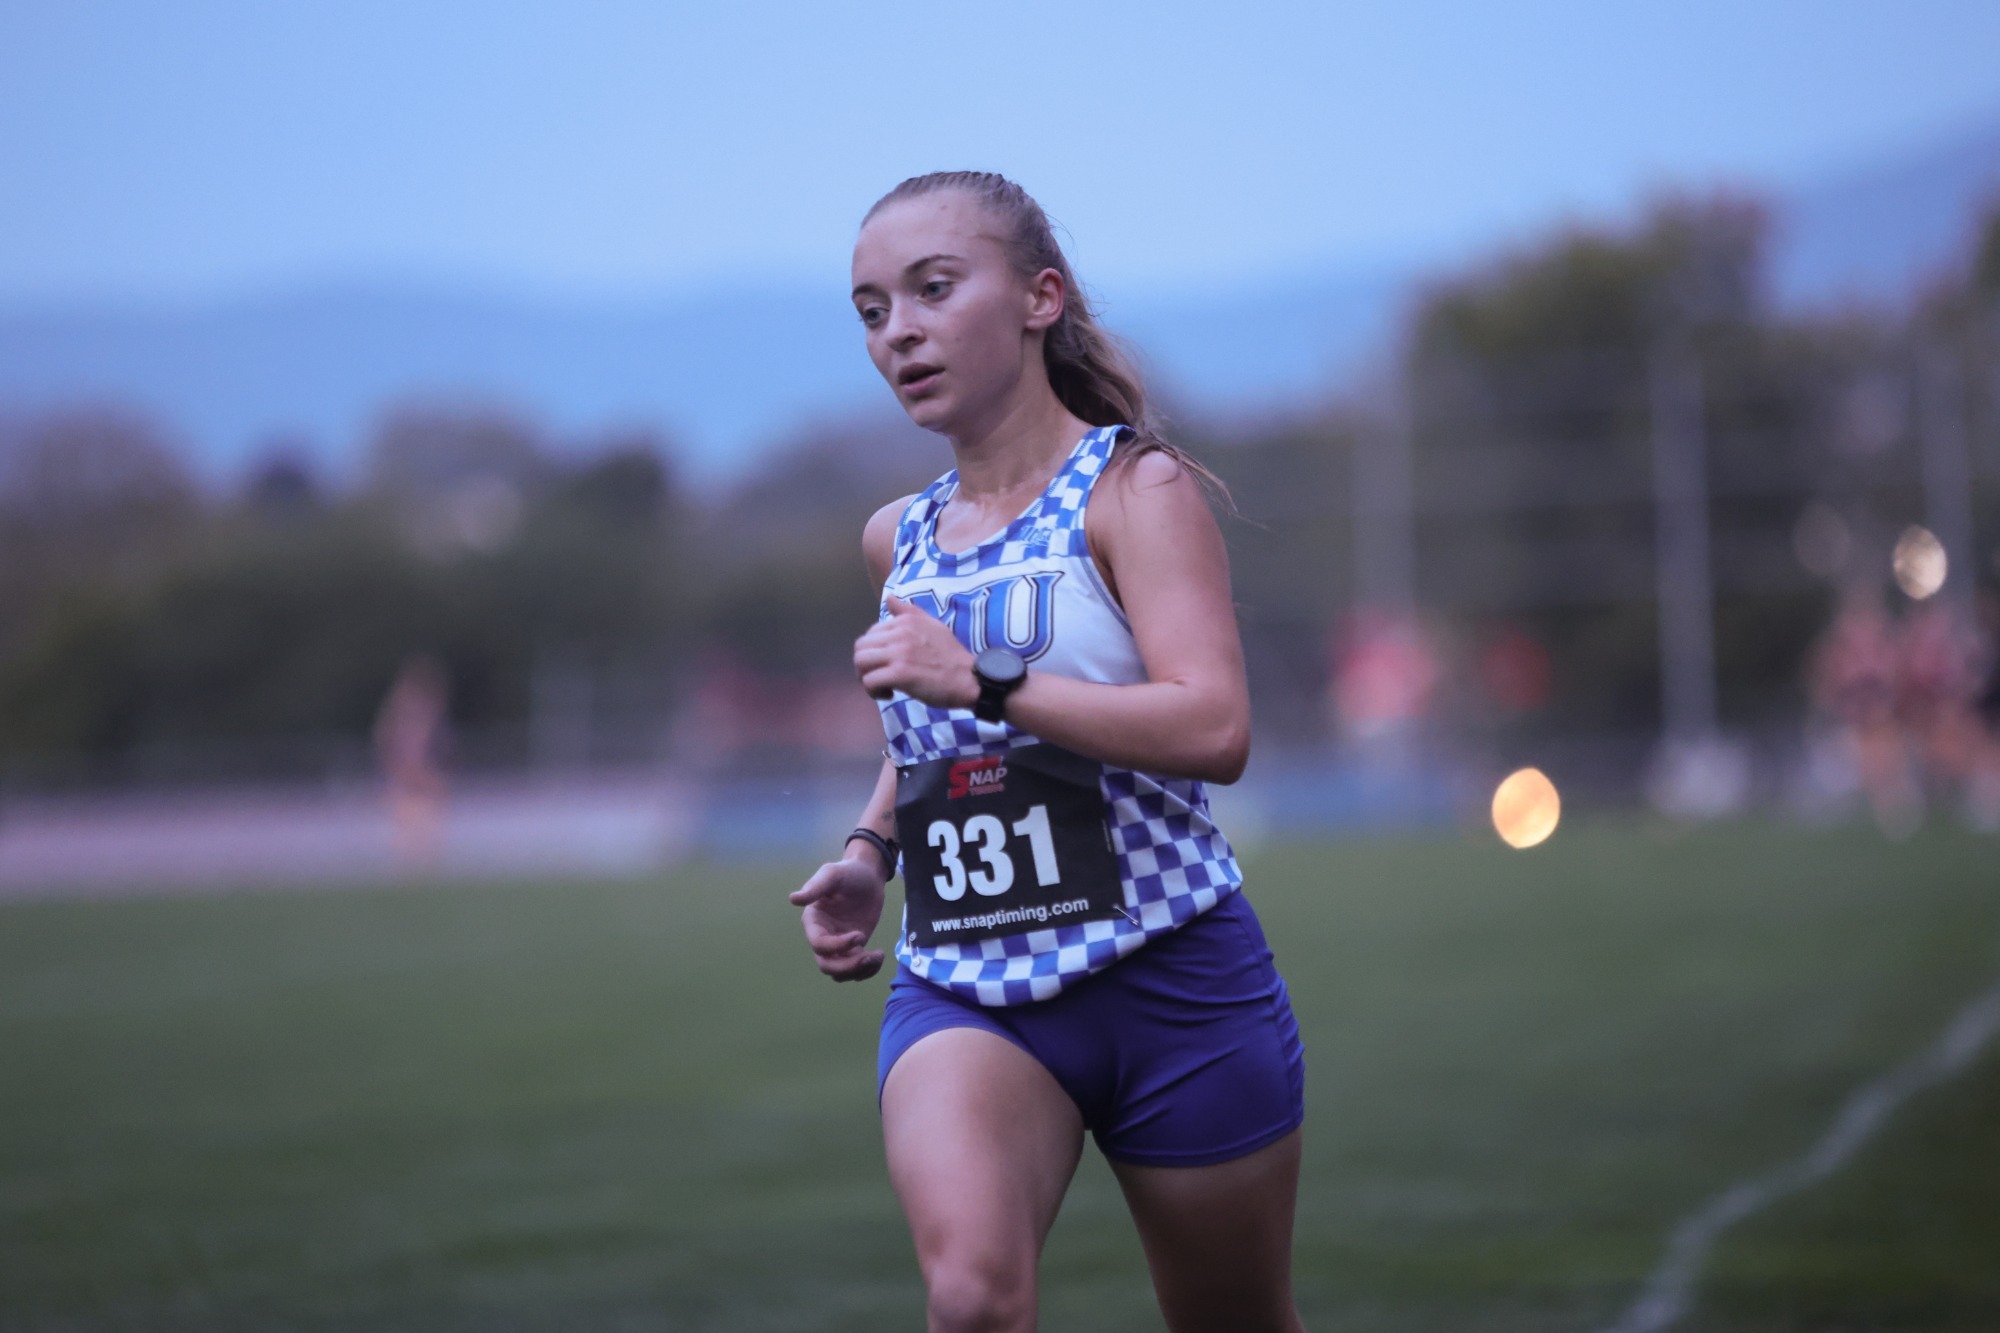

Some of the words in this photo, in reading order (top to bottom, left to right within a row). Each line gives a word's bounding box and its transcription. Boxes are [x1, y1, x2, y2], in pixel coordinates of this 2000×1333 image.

[948, 756, 1008, 799] SNAP
[927, 804, 1061, 902] 331
[931, 898, 1089, 933] www.snaptiming.com
